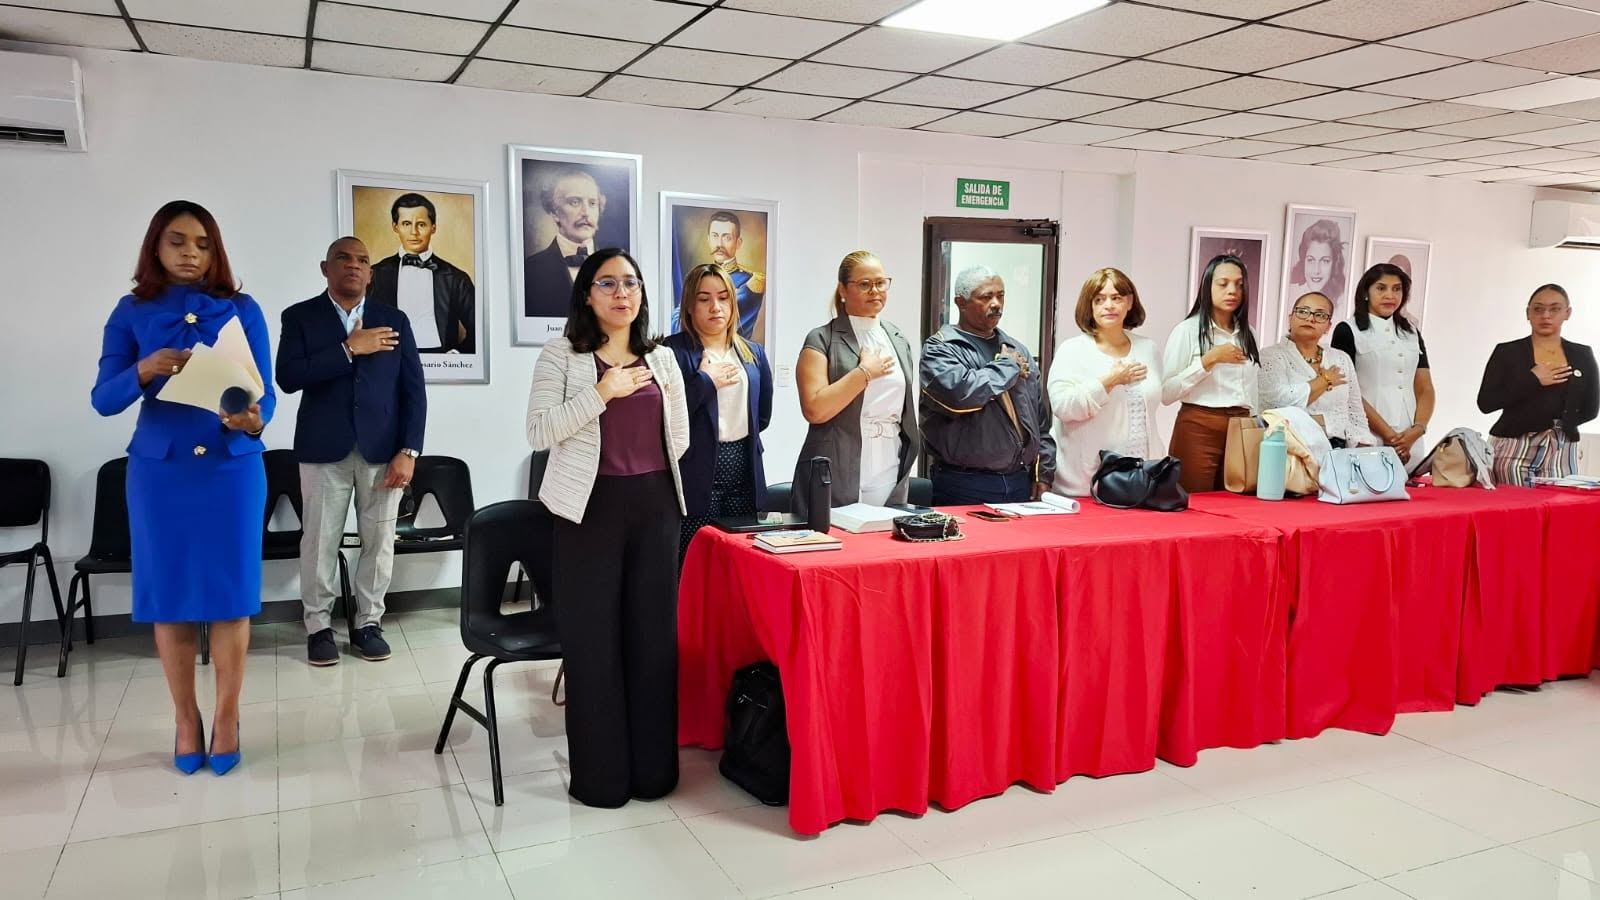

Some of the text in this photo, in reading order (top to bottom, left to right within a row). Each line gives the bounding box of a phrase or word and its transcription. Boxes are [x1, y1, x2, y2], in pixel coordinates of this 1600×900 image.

[964, 182, 1002, 195] SALIDA DE
[962, 195, 1004, 206] EMERGENCIA
[547, 324, 562, 332] Juan
